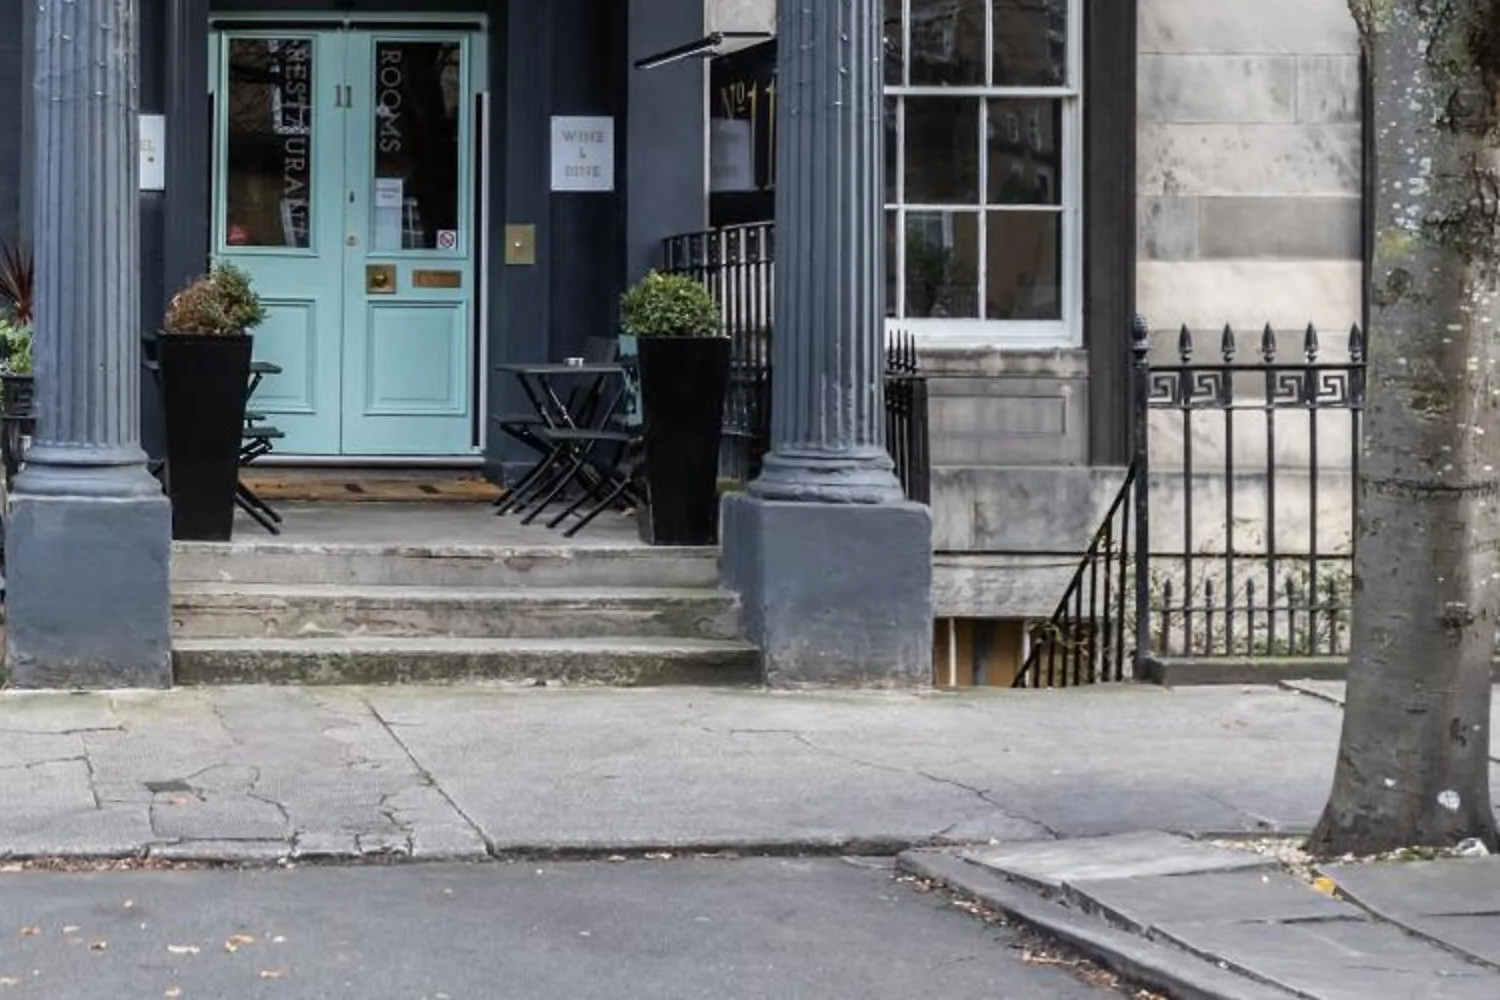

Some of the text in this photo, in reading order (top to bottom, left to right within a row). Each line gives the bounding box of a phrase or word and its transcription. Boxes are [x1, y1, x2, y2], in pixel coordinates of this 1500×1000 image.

[333, 84, 352, 109] 11
[379, 49, 402, 153] ROOMS
[562, 129, 604, 143] WINE
[564, 165, 602, 178] DINE
